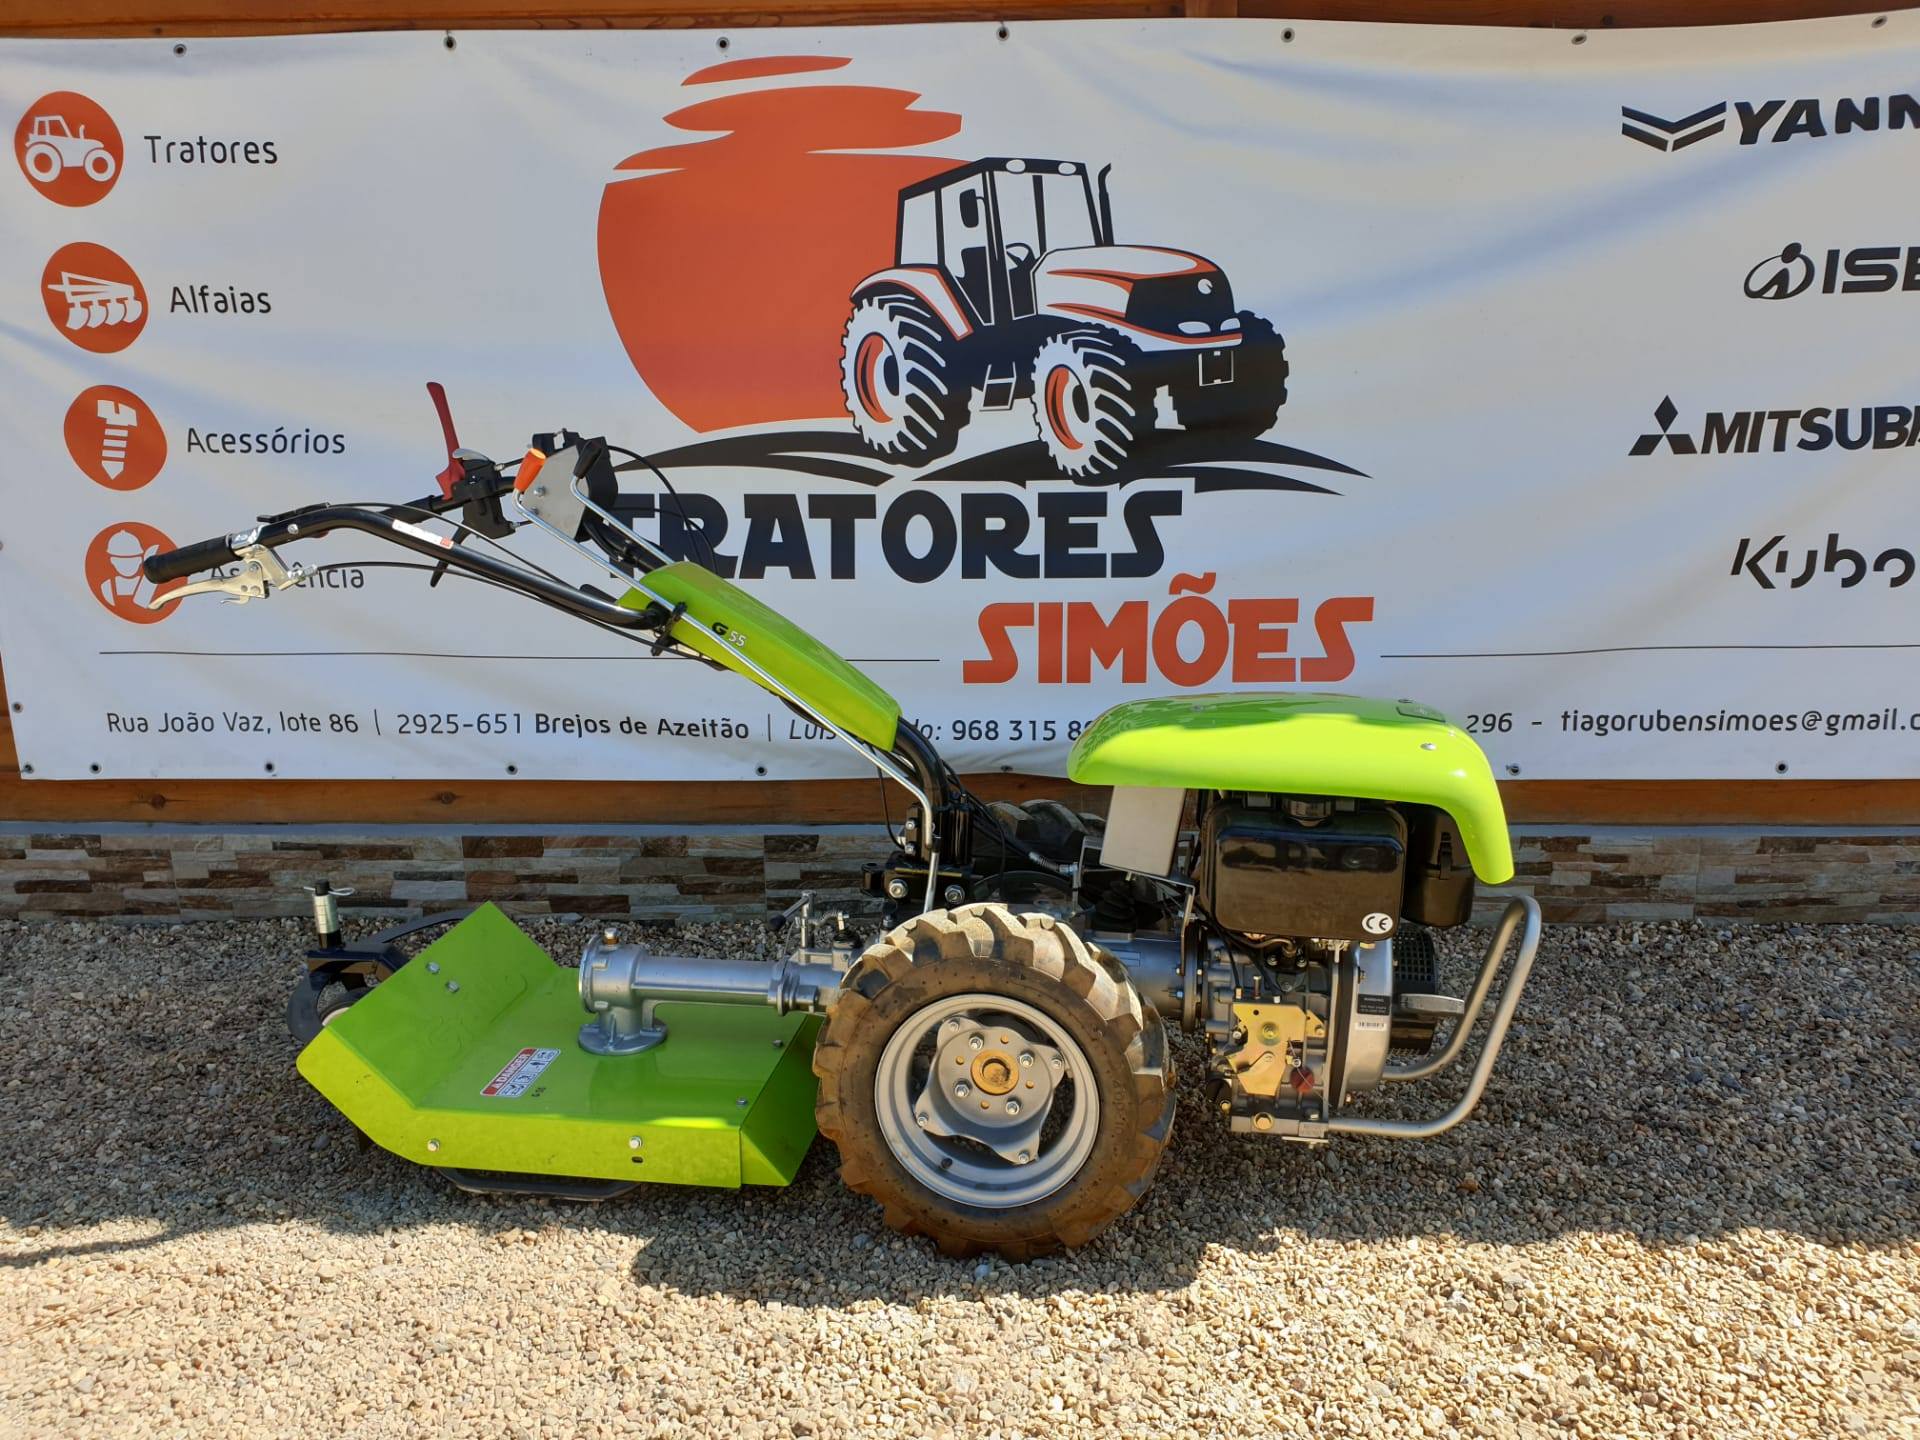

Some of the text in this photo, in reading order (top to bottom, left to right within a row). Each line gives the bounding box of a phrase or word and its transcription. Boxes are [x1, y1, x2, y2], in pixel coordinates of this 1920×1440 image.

[143, 135, 278, 165] Tratores
[170, 284, 272, 314] Alfaias
[187, 426, 346, 455] Acessórios
[729, 630, 746, 647] 55
[963, 573, 1374, 687] SIMÕES
[106, 712, 149, 733] Rua
[157, 711, 215, 733] João
[222, 711, 271, 735] Vaz,
[279, 710, 322, 733] lote
[328, 713, 359, 733] 86
[396, 713, 522, 735] 2925-651
[535, 713, 611, 739] Brejos
[619, 716, 648, 735] de
[657, 717, 749, 739] Azeitão
[951, 719, 999, 741] 968
[1009, 720, 1057, 741] 315
[1465, 712, 1513, 734] 296
[1366, 915, 1389, 931] CE
